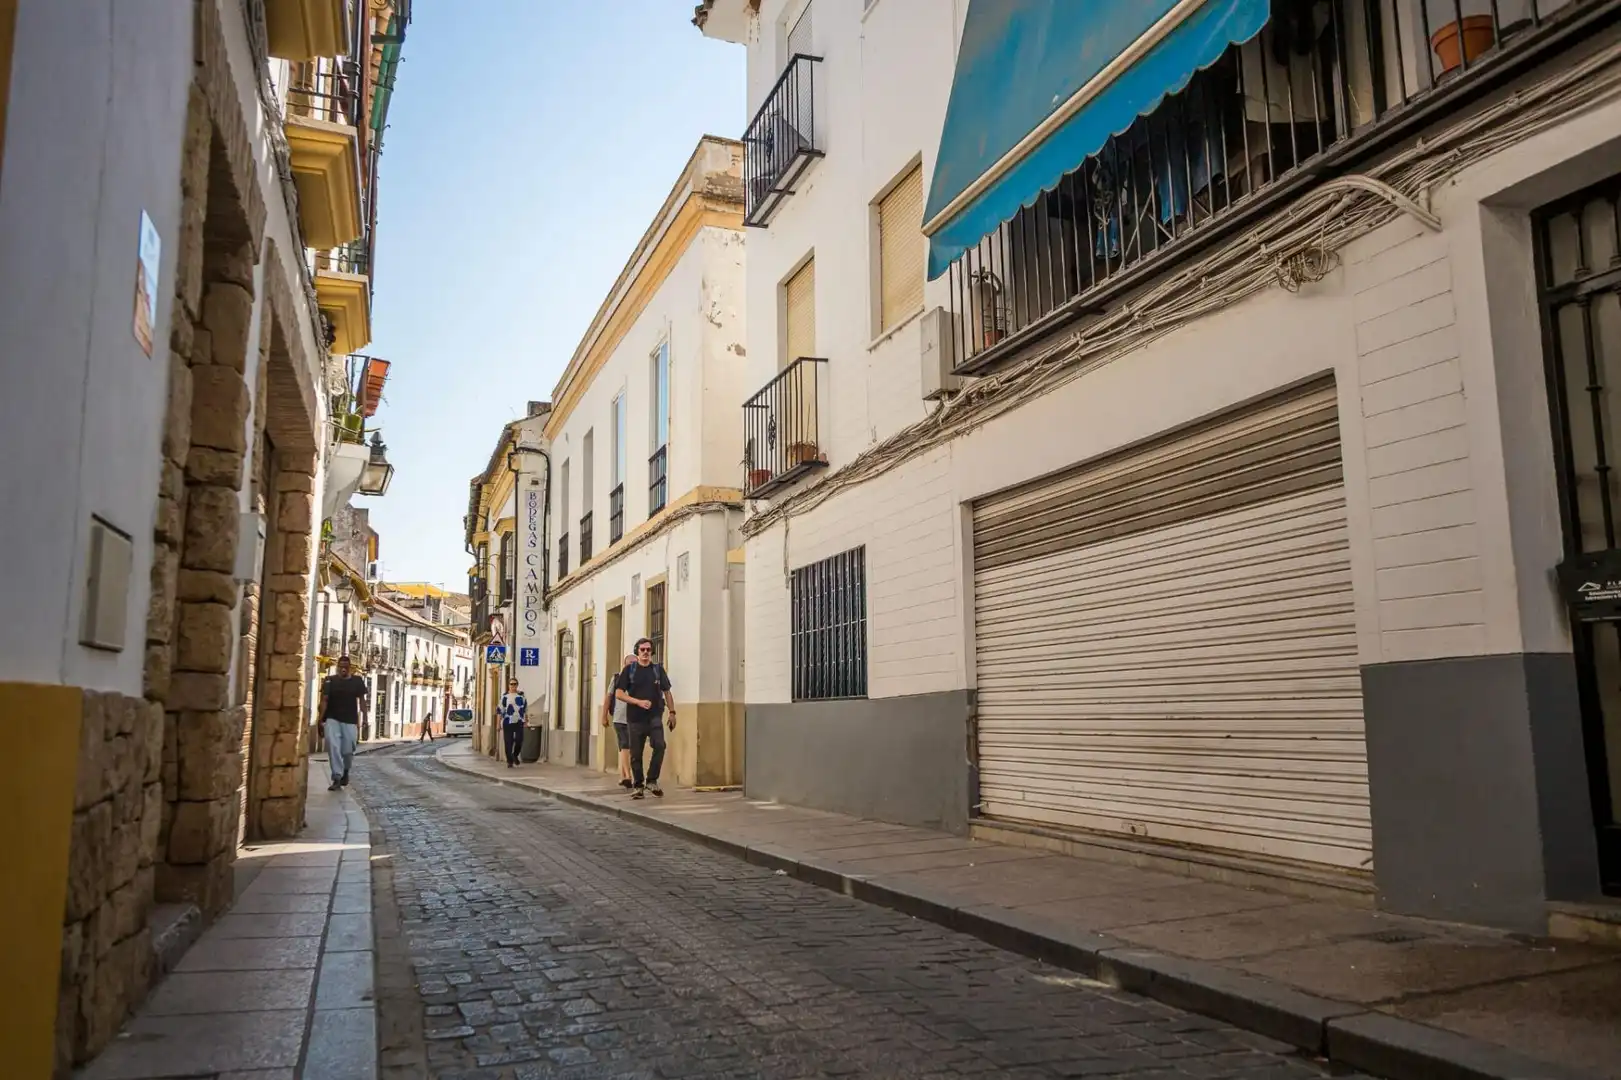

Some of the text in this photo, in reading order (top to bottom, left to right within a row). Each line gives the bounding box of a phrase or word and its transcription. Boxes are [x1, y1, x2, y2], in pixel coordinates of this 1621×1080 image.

[525, 491, 538, 637] BODEGAS CAMPOS
[525, 649, 536, 659] R
